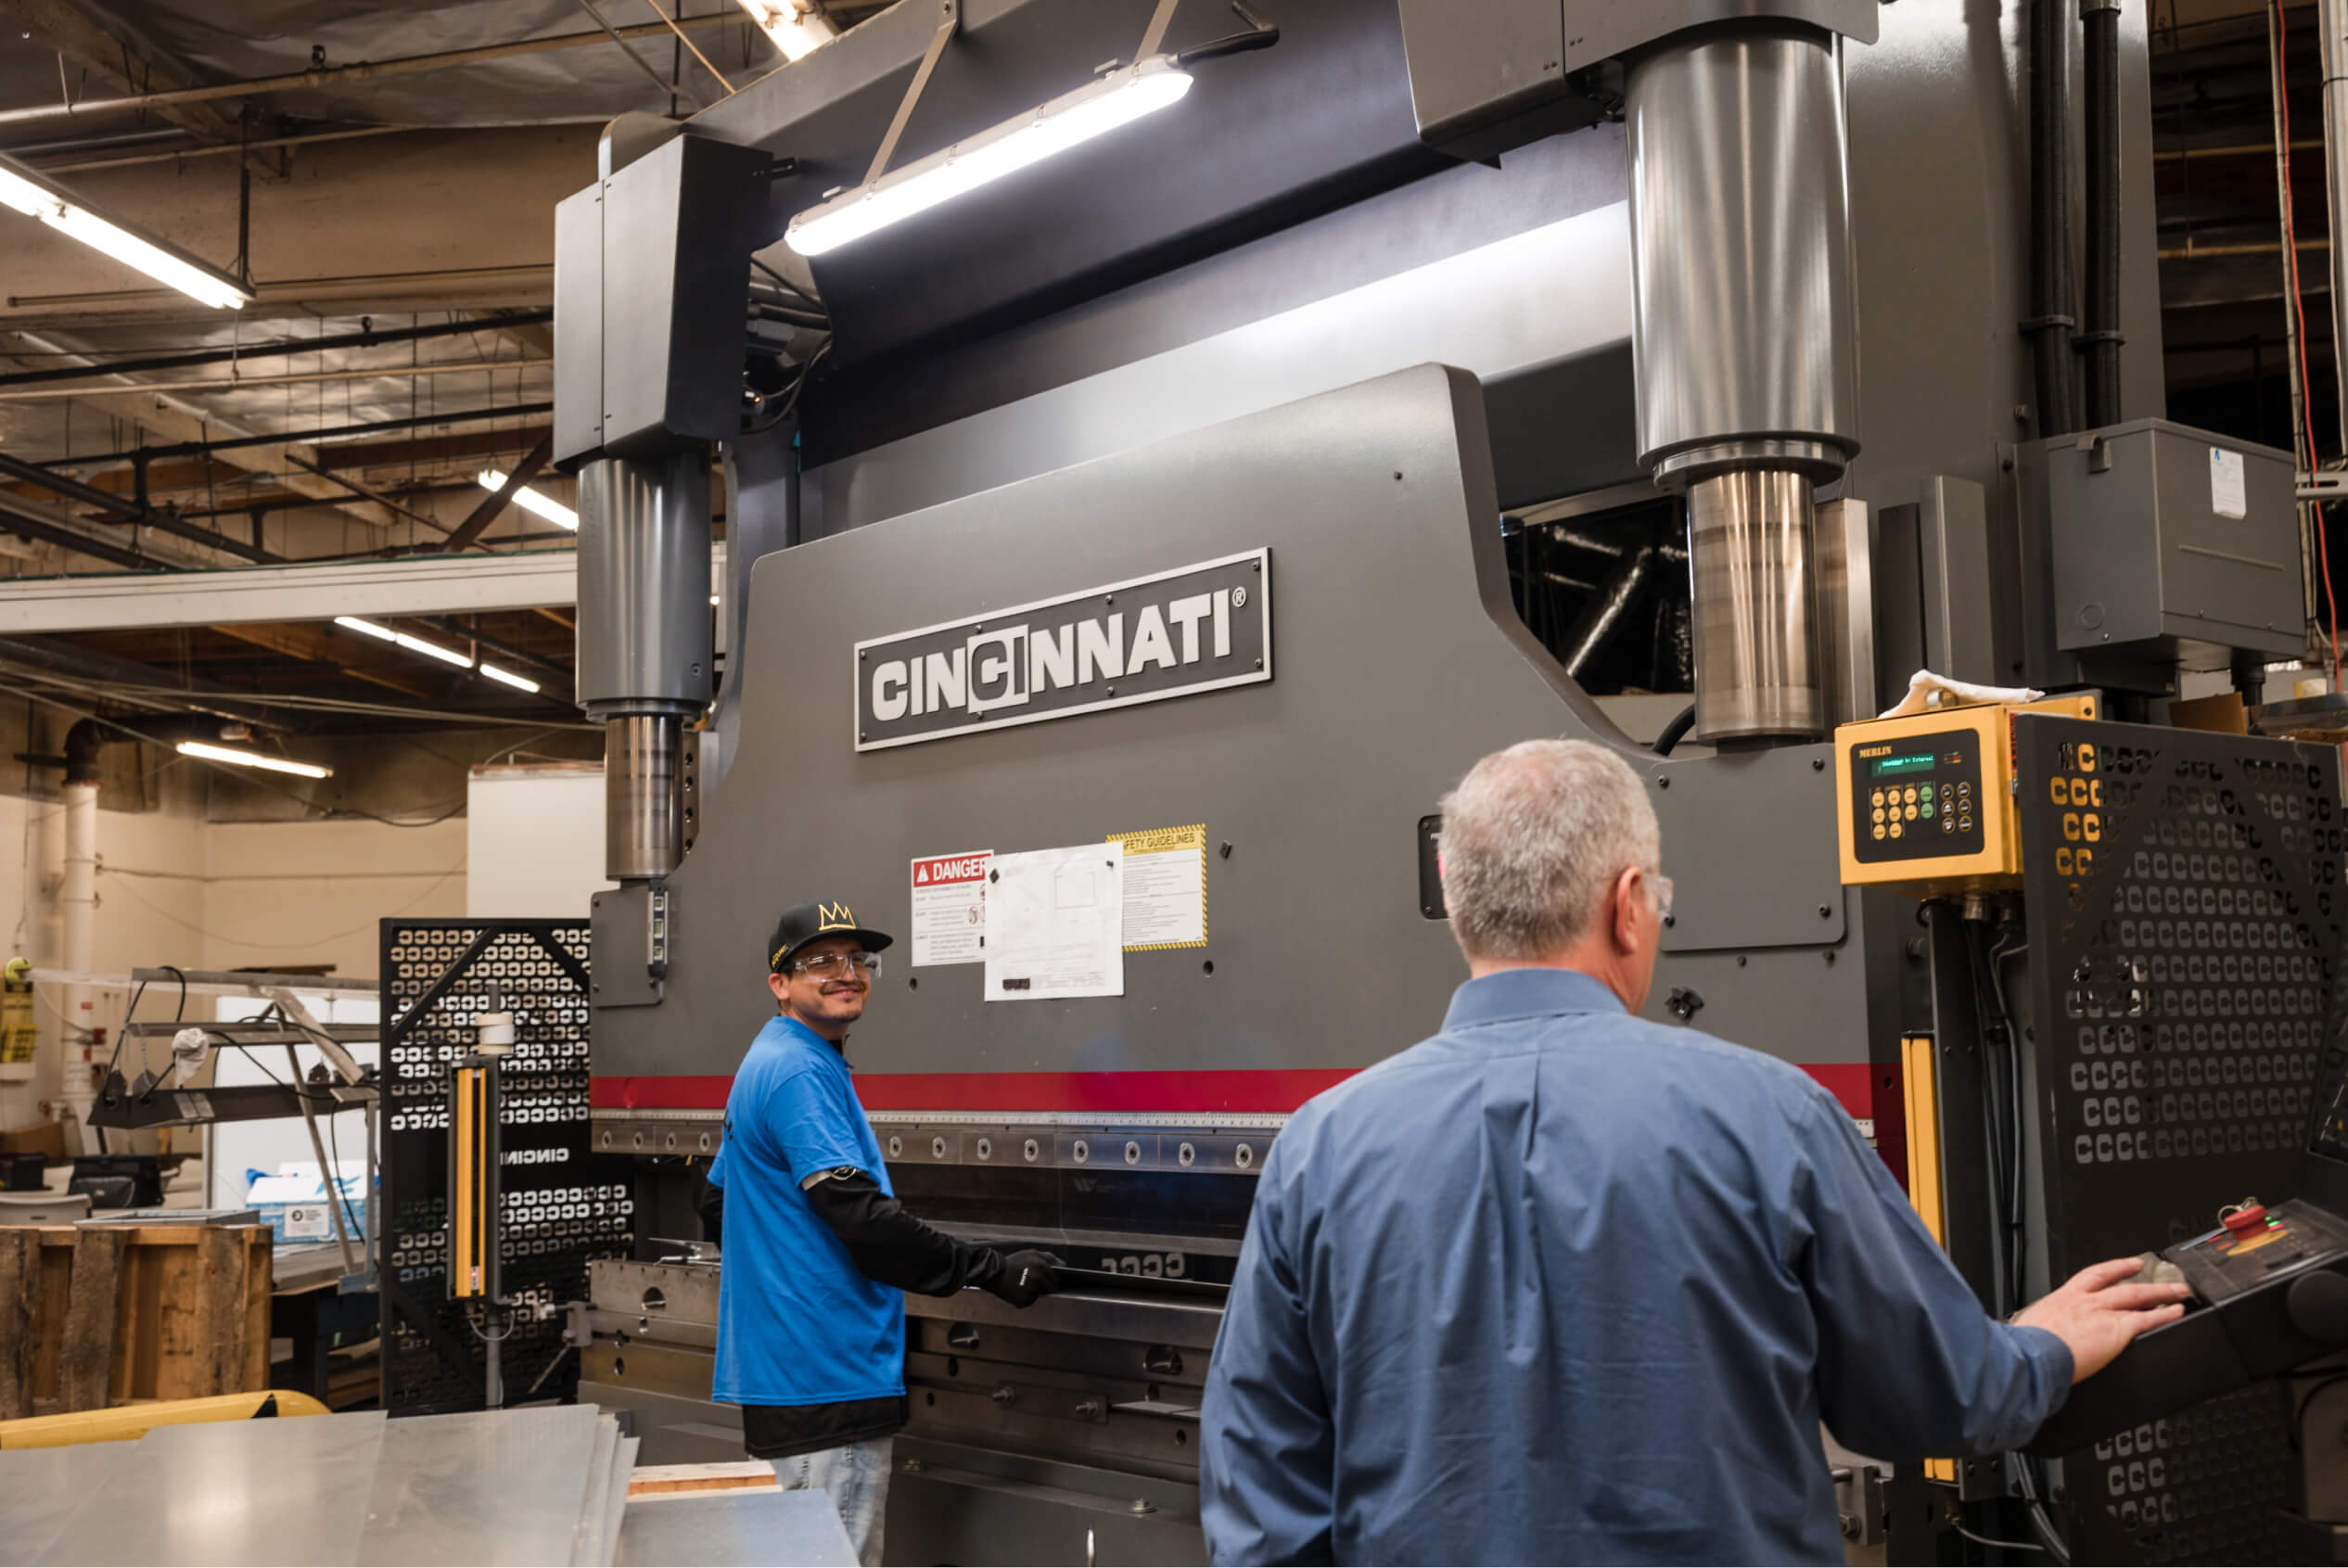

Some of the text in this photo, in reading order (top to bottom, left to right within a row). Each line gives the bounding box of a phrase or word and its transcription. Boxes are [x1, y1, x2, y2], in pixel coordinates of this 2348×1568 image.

[1858, 746, 1892, 759] MERLIN
[1124, 837, 1145, 850] FETY
[1146, 833, 1195, 848] GUIDELINES
